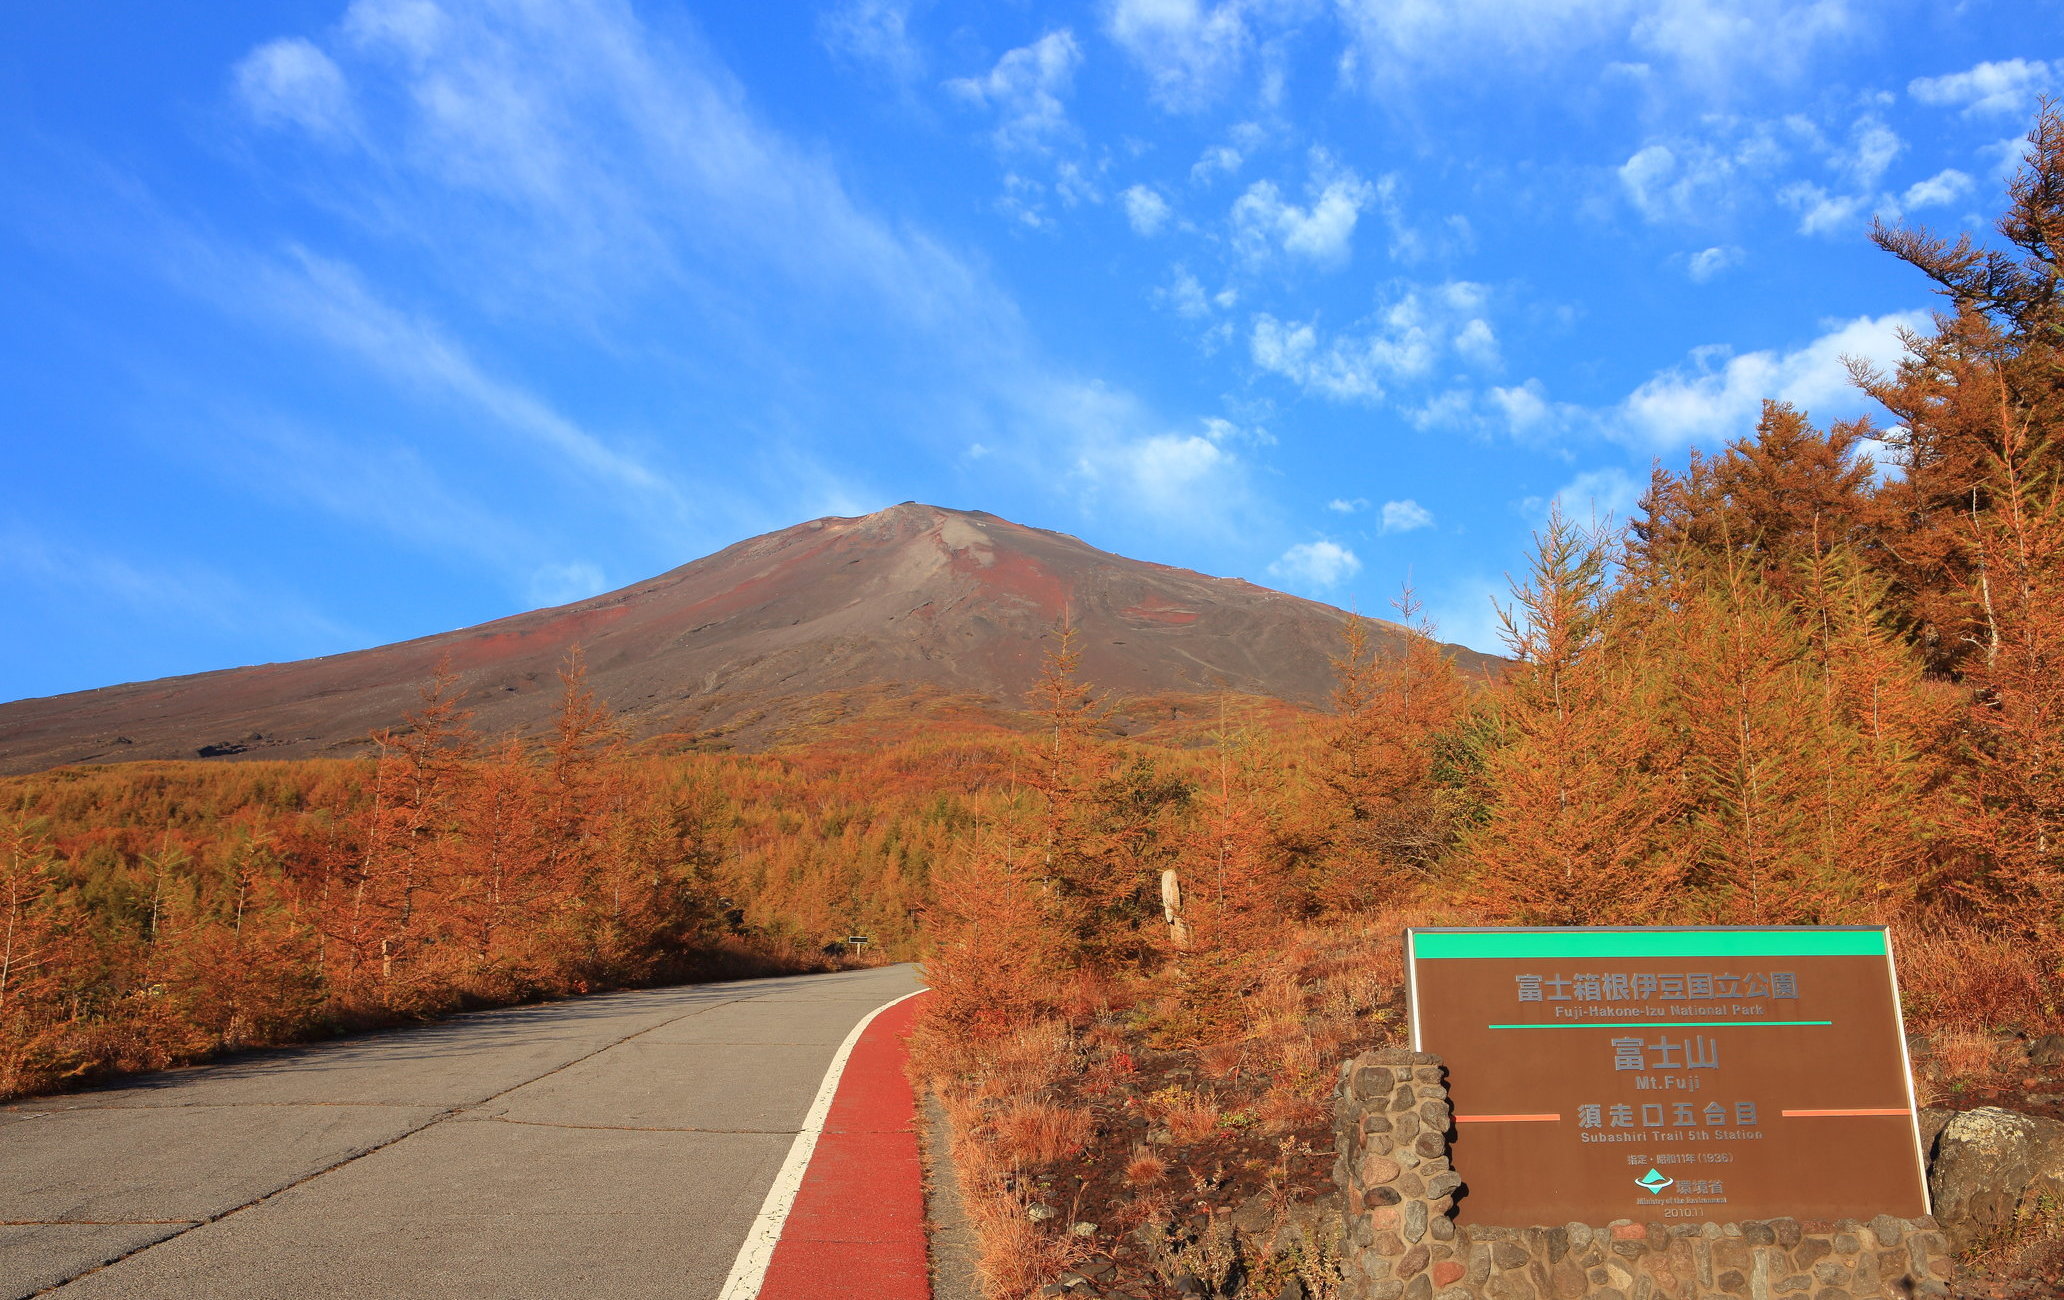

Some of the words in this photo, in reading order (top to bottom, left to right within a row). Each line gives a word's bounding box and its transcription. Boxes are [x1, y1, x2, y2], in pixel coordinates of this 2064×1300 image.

[1515, 972, 1798, 1001] 富士箱根伊豆国立公園
[1555, 1005, 1665, 1019] Fuji-Hakone-Izu
[1670, 1004, 1727, 1016] National
[1732, 1004, 1764, 1015] Park
[1611, 1034, 1719, 1070] 富士山
[1635, 1075, 1700, 1092] Mt.Fuji
[1577, 1101, 1758, 1128] 須走口五合目
[1581, 1131, 1647, 1143] Subashiri
[1652, 1130, 1683, 1142] Trail
[1688, 1130, 1709, 1141] 5th
[1715, 1129, 1762, 1140] Station
[1676, 1180, 1723, 1195] 環境省
[1637, 1198, 1664, 1206] Ministry
